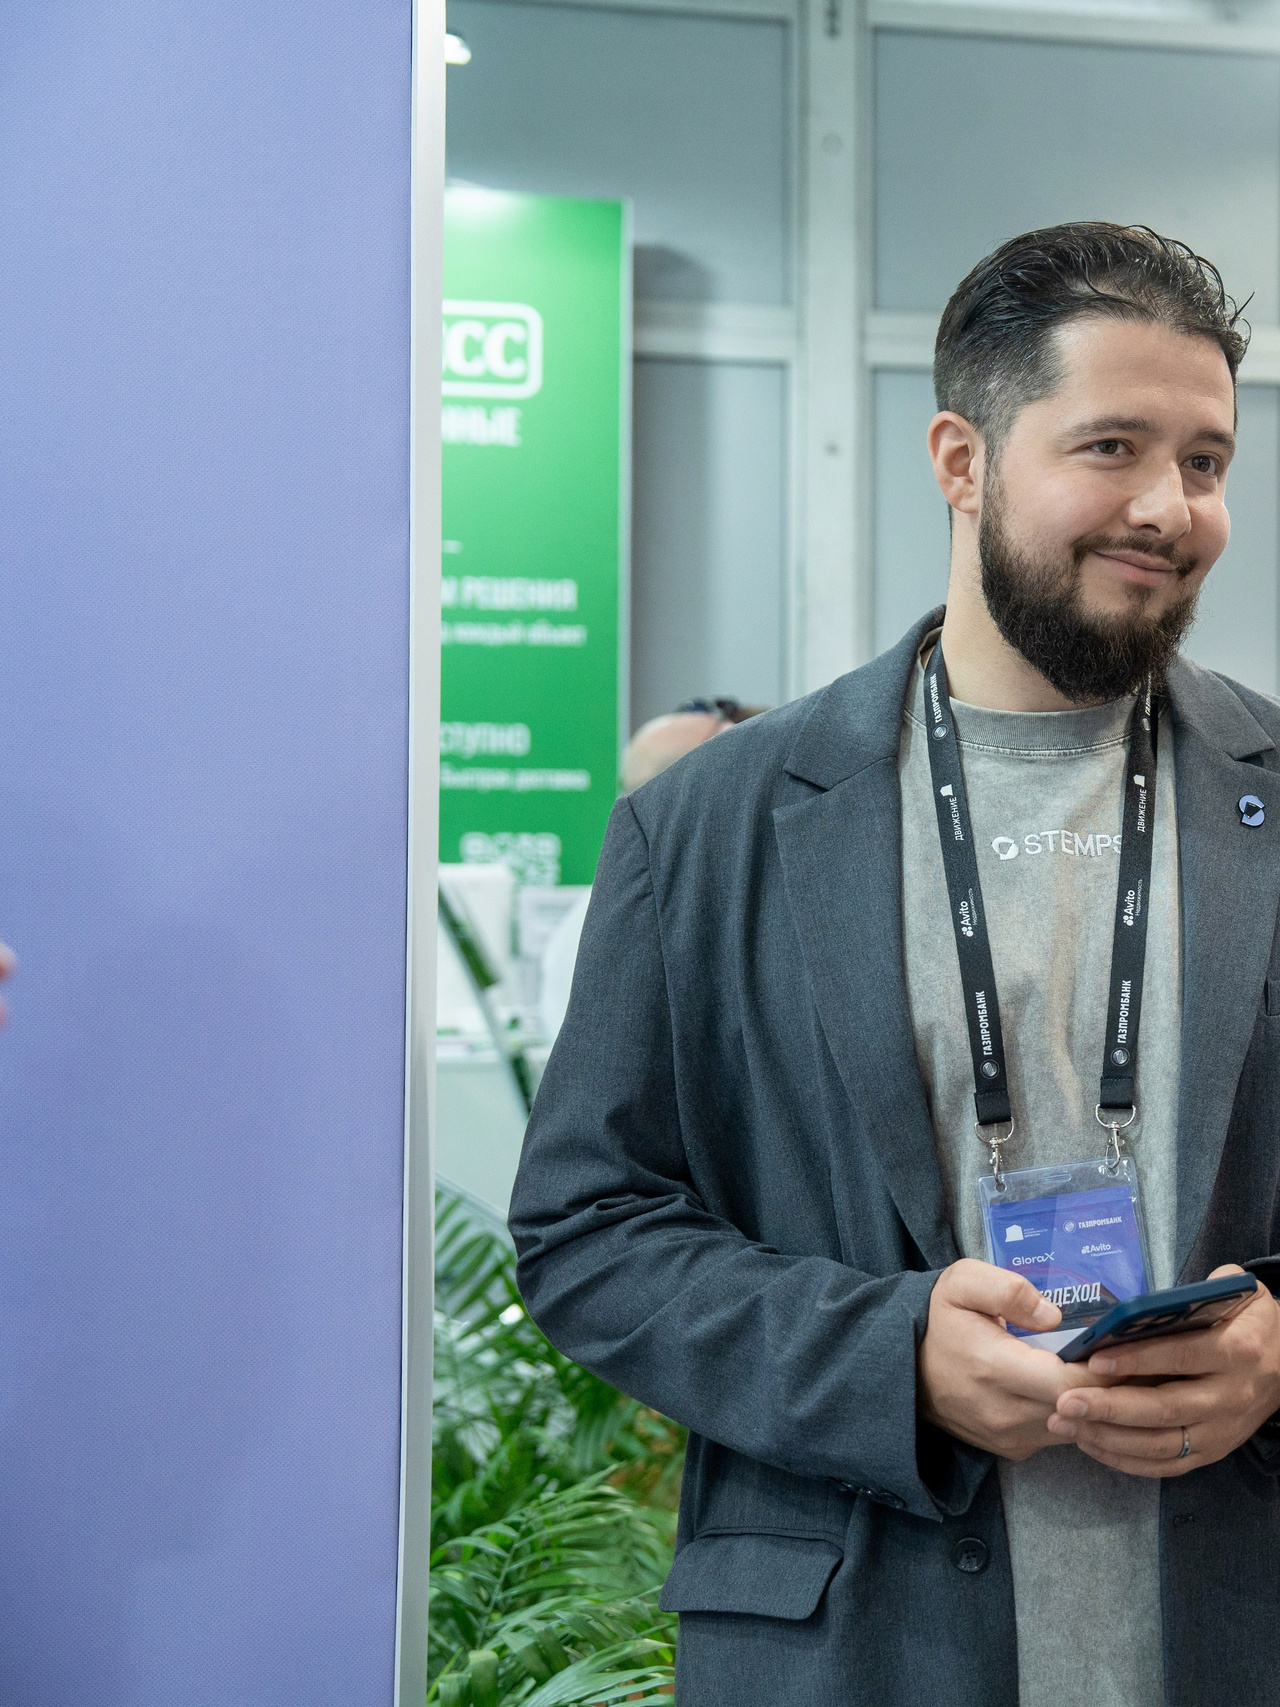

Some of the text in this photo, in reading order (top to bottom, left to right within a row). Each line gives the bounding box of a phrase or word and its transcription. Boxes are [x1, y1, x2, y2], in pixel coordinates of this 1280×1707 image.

[930, 673, 943, 723] ГАЗПРОМБАНК
[949, 796, 965, 841] ДВИЖЕНИЕ
[1136, 788, 1147, 833] ДВИЖЕНИЕ
[958, 900, 972, 926] Avito
[1123, 889, 1136, 916] Avito
[975, 990, 993, 1056] ГАЗПРОМБАНК
[1117, 979, 1132, 1044] ГАЗПРОМБАНК
[1078, 1216, 1123, 1229] ГАЗПРОМБАНК
[1012, 1251, 1055, 1266] GloraX
[1090, 1243, 1112, 1253] Avito
[1040, 1282, 1101, 1307] ЗДЕХОД
